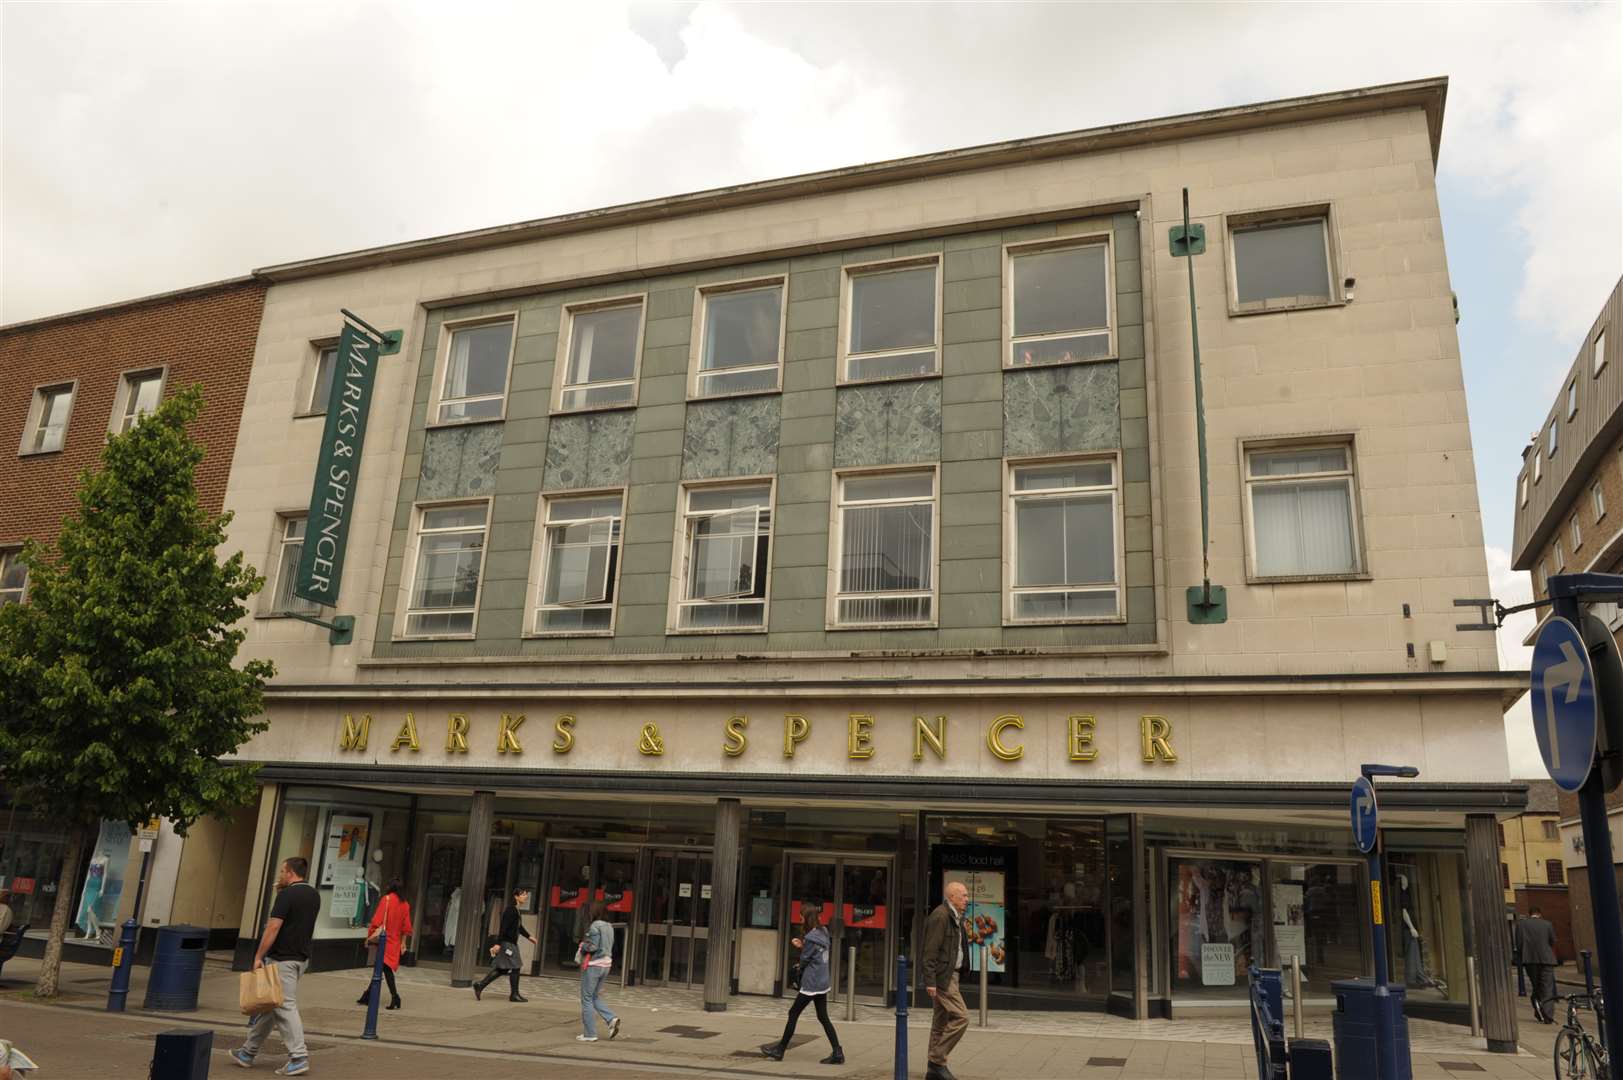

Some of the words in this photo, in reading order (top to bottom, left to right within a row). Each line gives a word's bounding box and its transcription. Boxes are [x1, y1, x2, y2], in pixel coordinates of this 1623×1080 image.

[335, 334, 371, 439] MARKS
[332, 439, 354, 458] &
[307, 464, 351, 594] SPENCER
[339, 711, 576, 754] MARKS
[637, 720, 665, 756] &
[722, 715, 1178, 763] SPENCER
[968, 855, 988, 865] food
[1213, 952, 1231, 961] NEW
